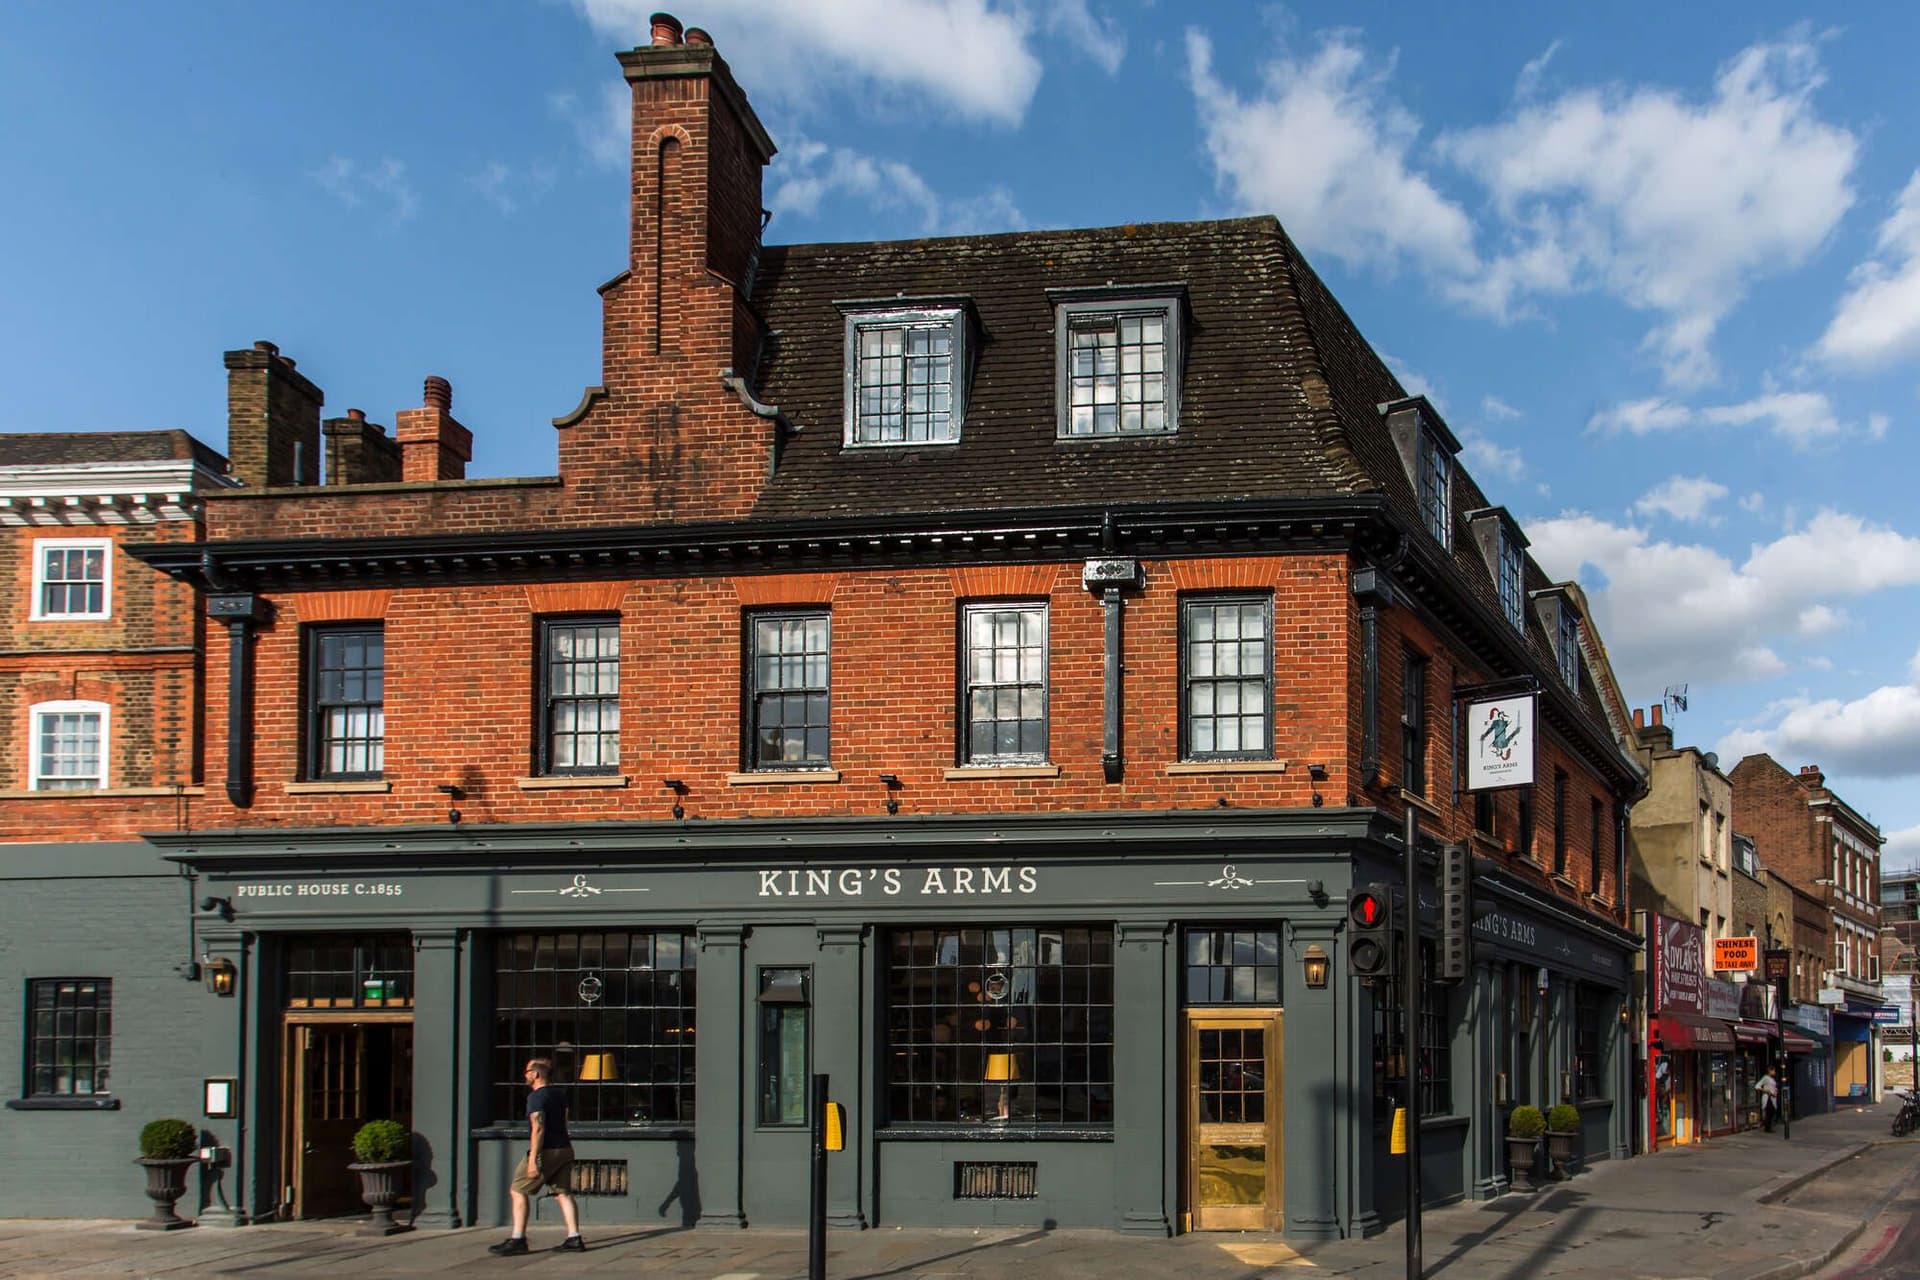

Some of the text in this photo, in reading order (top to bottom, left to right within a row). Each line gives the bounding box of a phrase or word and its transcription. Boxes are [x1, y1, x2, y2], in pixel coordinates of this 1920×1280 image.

[1223, 864, 1236, 879] G
[573, 874, 586, 888] G
[758, 866, 1037, 897] KING'S ARMS
[237, 883, 402, 897] PUBLIC HOUSE C.1855
[1511, 920, 1536, 946] ARMS
[1716, 939, 1755, 949] CHINESE
[1670, 945, 1698, 973] DYLAN'S
[1724, 950, 1747, 959] FOOD
[1716, 960, 1755, 969] TO TAKE AWAY
